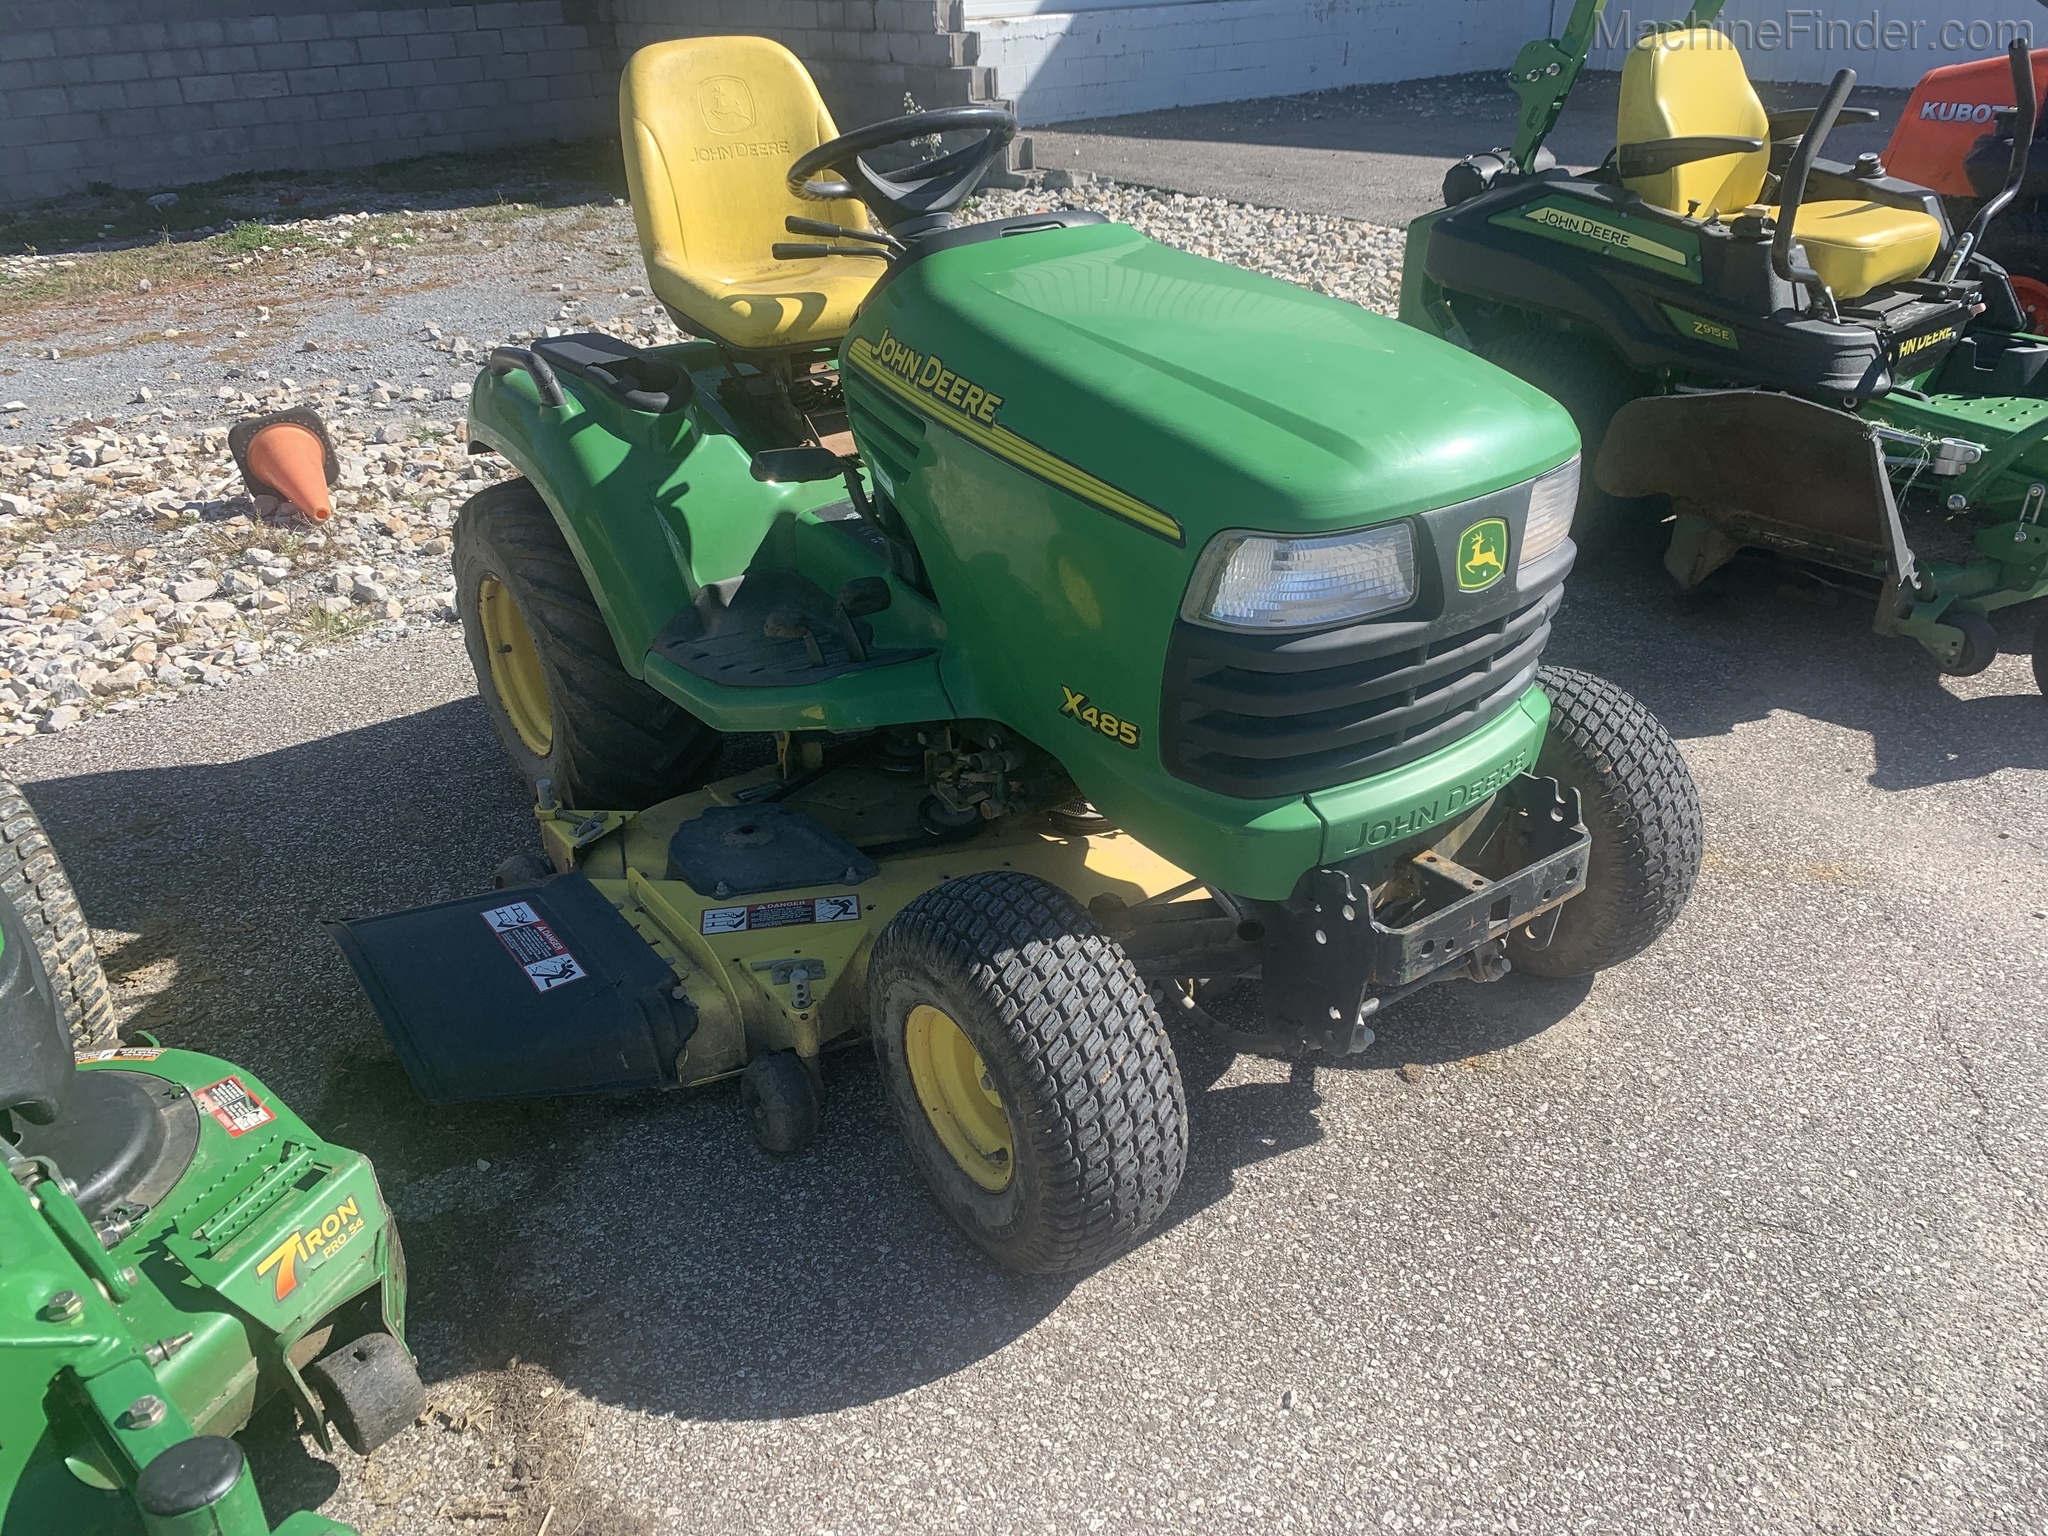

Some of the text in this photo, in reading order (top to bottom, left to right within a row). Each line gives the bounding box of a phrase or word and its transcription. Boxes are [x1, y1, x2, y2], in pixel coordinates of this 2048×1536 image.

[1919, 101, 2009, 124] KUBOT
[691, 140, 790, 163] JOHN DEERE
[1539, 210, 1631, 246] JOHN DEERE
[1693, 321, 1730, 341] Z915E
[870, 328, 1003, 423] JOHN DEERE
[1060, 685, 1140, 748] X485
[1344, 749, 1527, 855] JOHN DEERE
[767, 900, 807, 910] DANGER
[542, 928, 564, 951] DANGER
[322, 1217, 364, 1259] PRO 54
